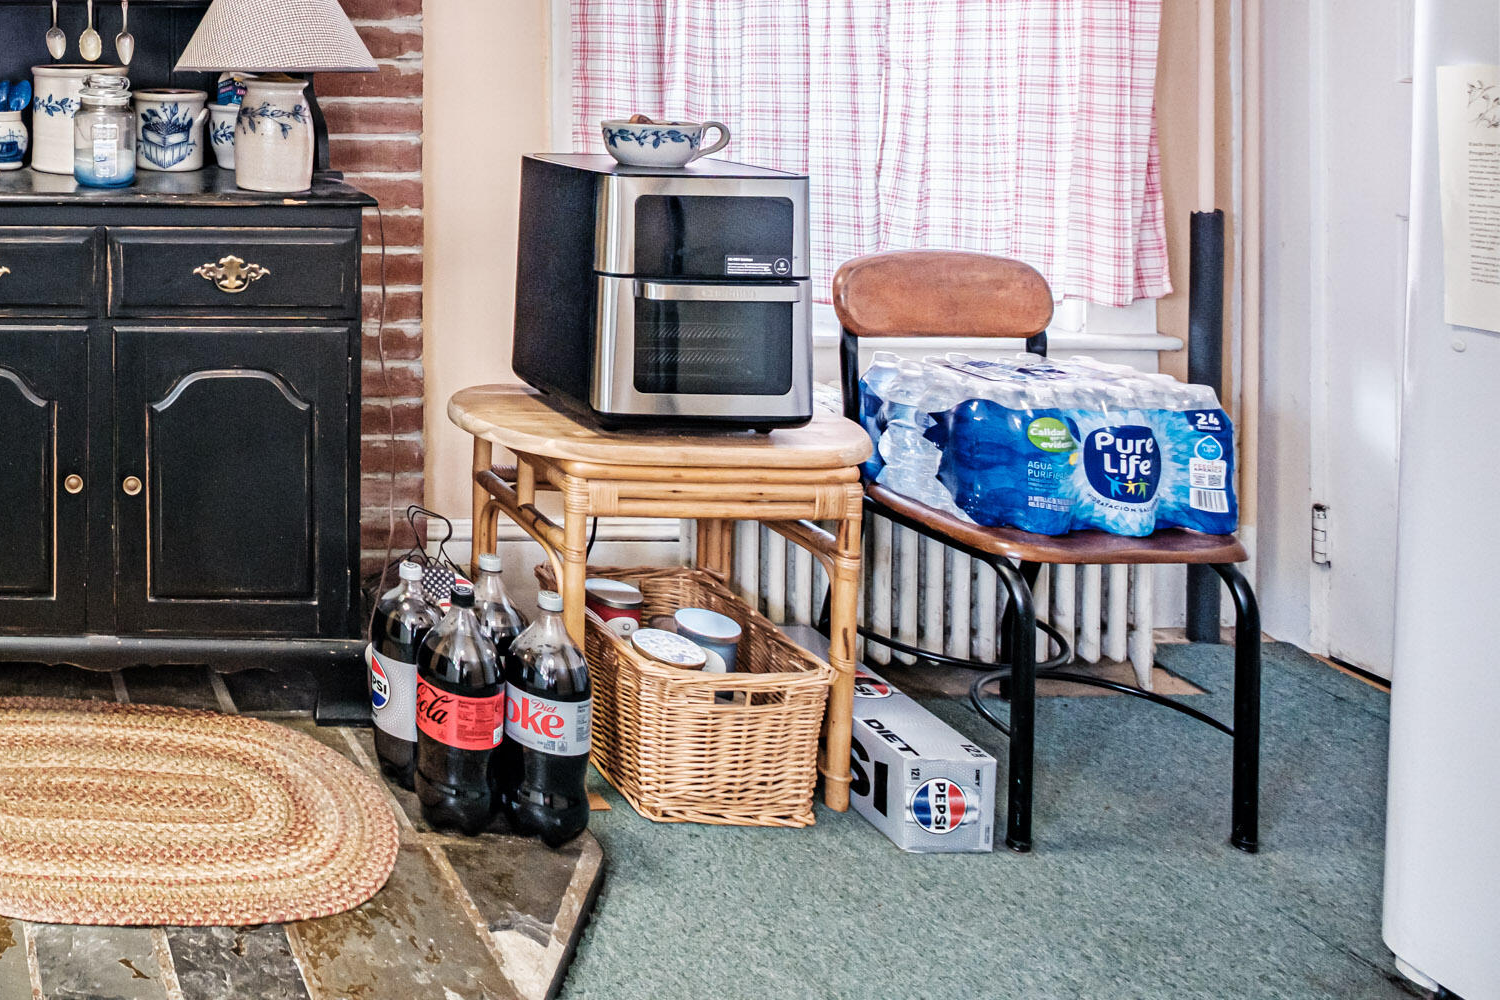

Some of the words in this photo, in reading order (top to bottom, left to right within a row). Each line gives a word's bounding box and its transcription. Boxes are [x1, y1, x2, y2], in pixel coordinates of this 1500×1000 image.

[1195, 412, 1220, 426] 24
[1094, 431, 1154, 455] Pure
[1027, 460, 1053, 470] AGUA
[1103, 453, 1152, 480] Life
[530, 698, 558, 714] Diet
[862, 718, 920, 757] DIET
[911, 768, 920, 776] 12
[934, 782, 947, 830] PEPSI
